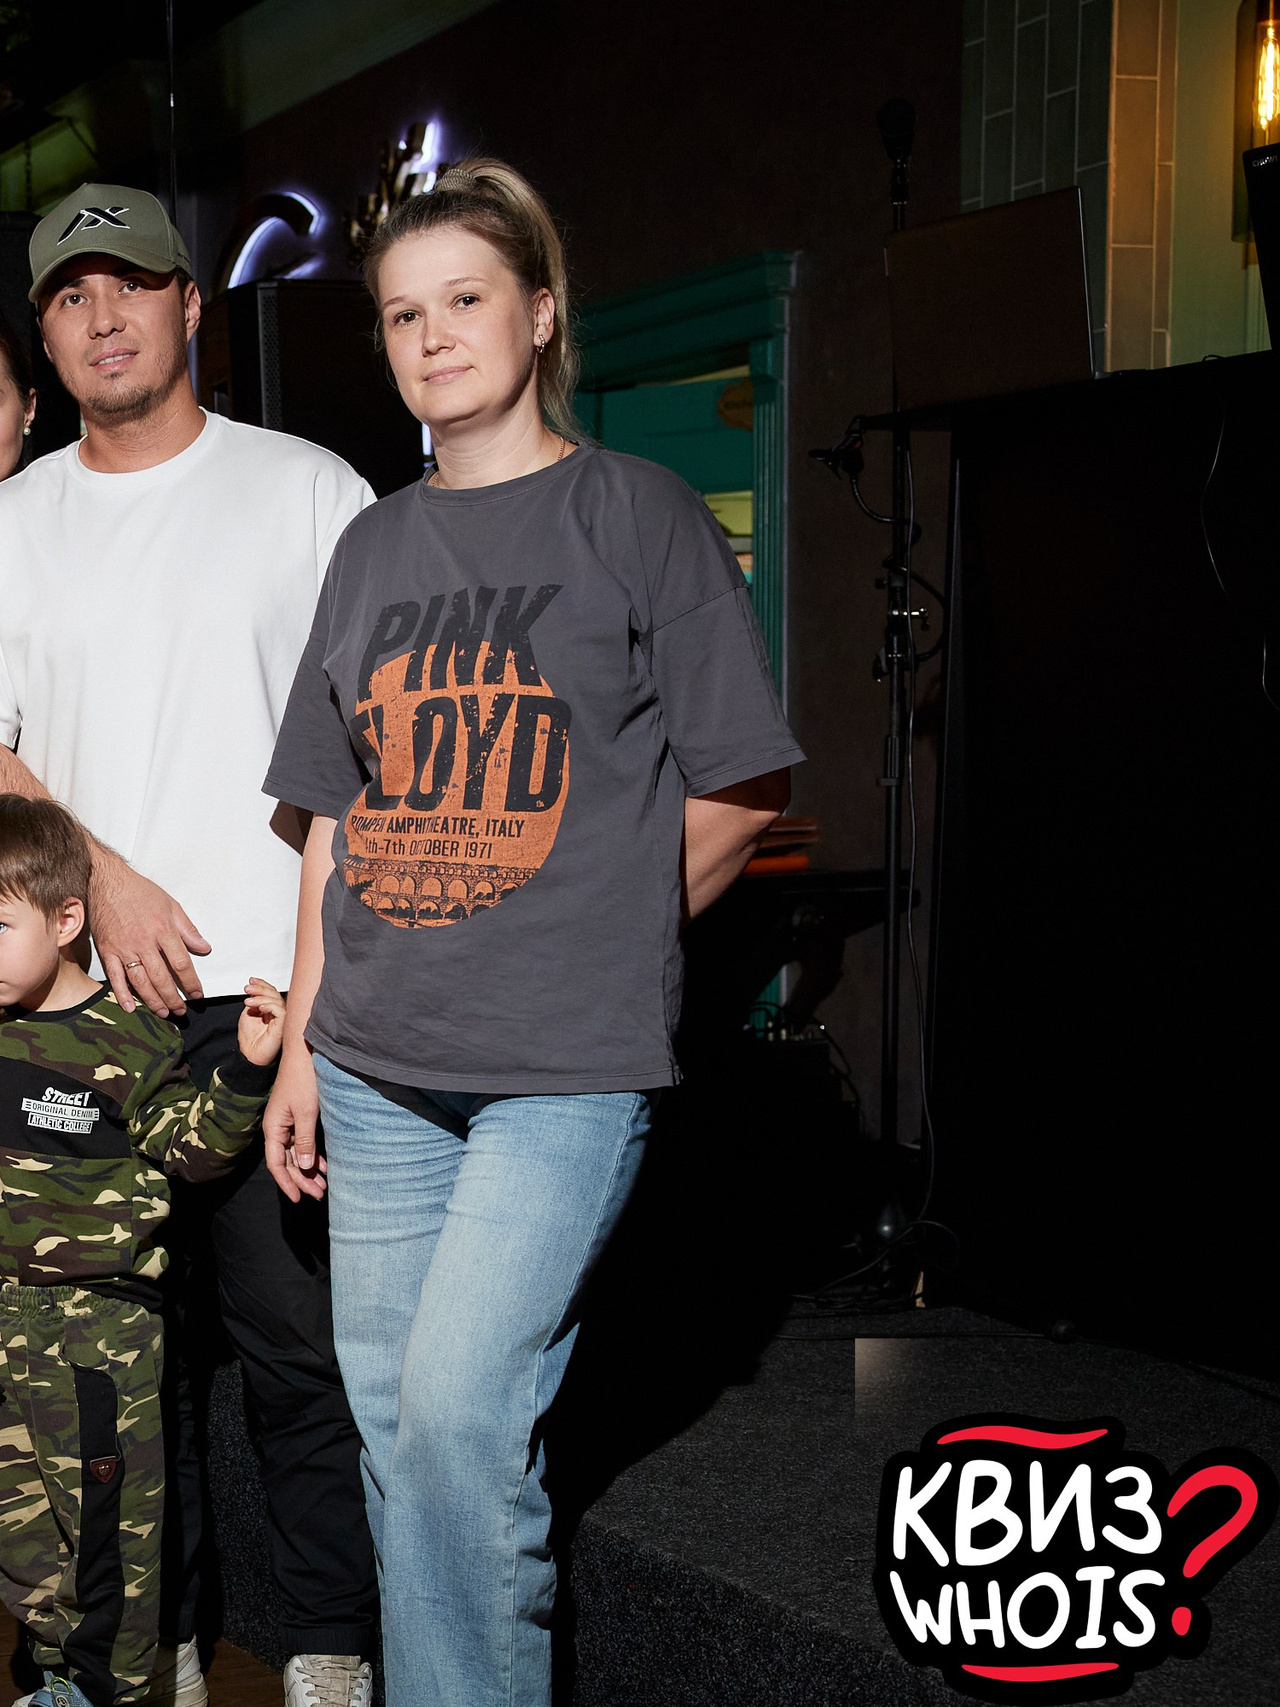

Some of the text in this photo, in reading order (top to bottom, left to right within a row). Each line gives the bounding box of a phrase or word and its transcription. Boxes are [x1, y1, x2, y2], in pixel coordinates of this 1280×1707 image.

[357, 584, 564, 702] PINK
[387, 816, 480, 838] AMPHITHEATRE,
[485, 819, 525, 838] ITALY
[409, 839, 459, 857] OCTOBER
[464, 842, 492, 858] 1971
[32, 1102, 94, 1119] ORIGINAL DENIM
[31, 1115, 91, 1133] ATHLETIC COLLEGE
